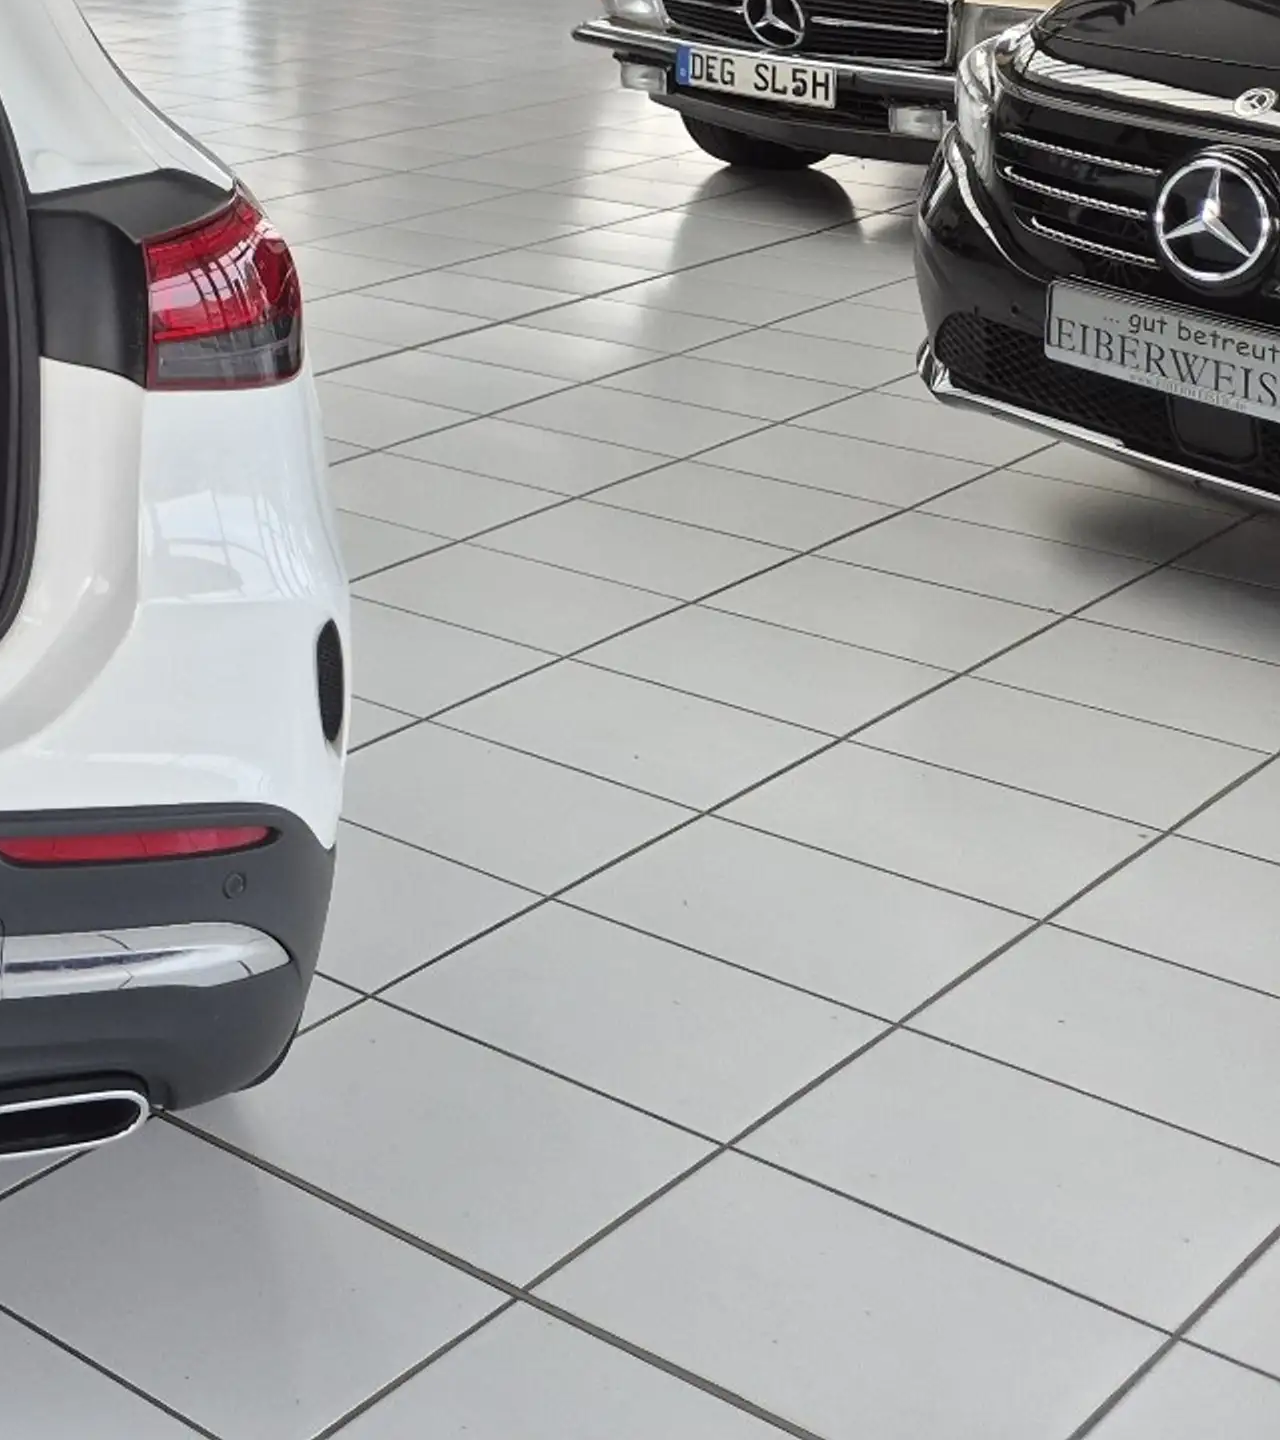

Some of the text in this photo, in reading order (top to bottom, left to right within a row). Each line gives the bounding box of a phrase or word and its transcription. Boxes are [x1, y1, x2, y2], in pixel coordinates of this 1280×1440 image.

[691, 53, 830, 102] DEG SL5H
[1055, 316, 1278, 408] EIBERWEIS
[1128, 313, 1168, 334] gut
[1177, 319, 1280, 364] betreut
